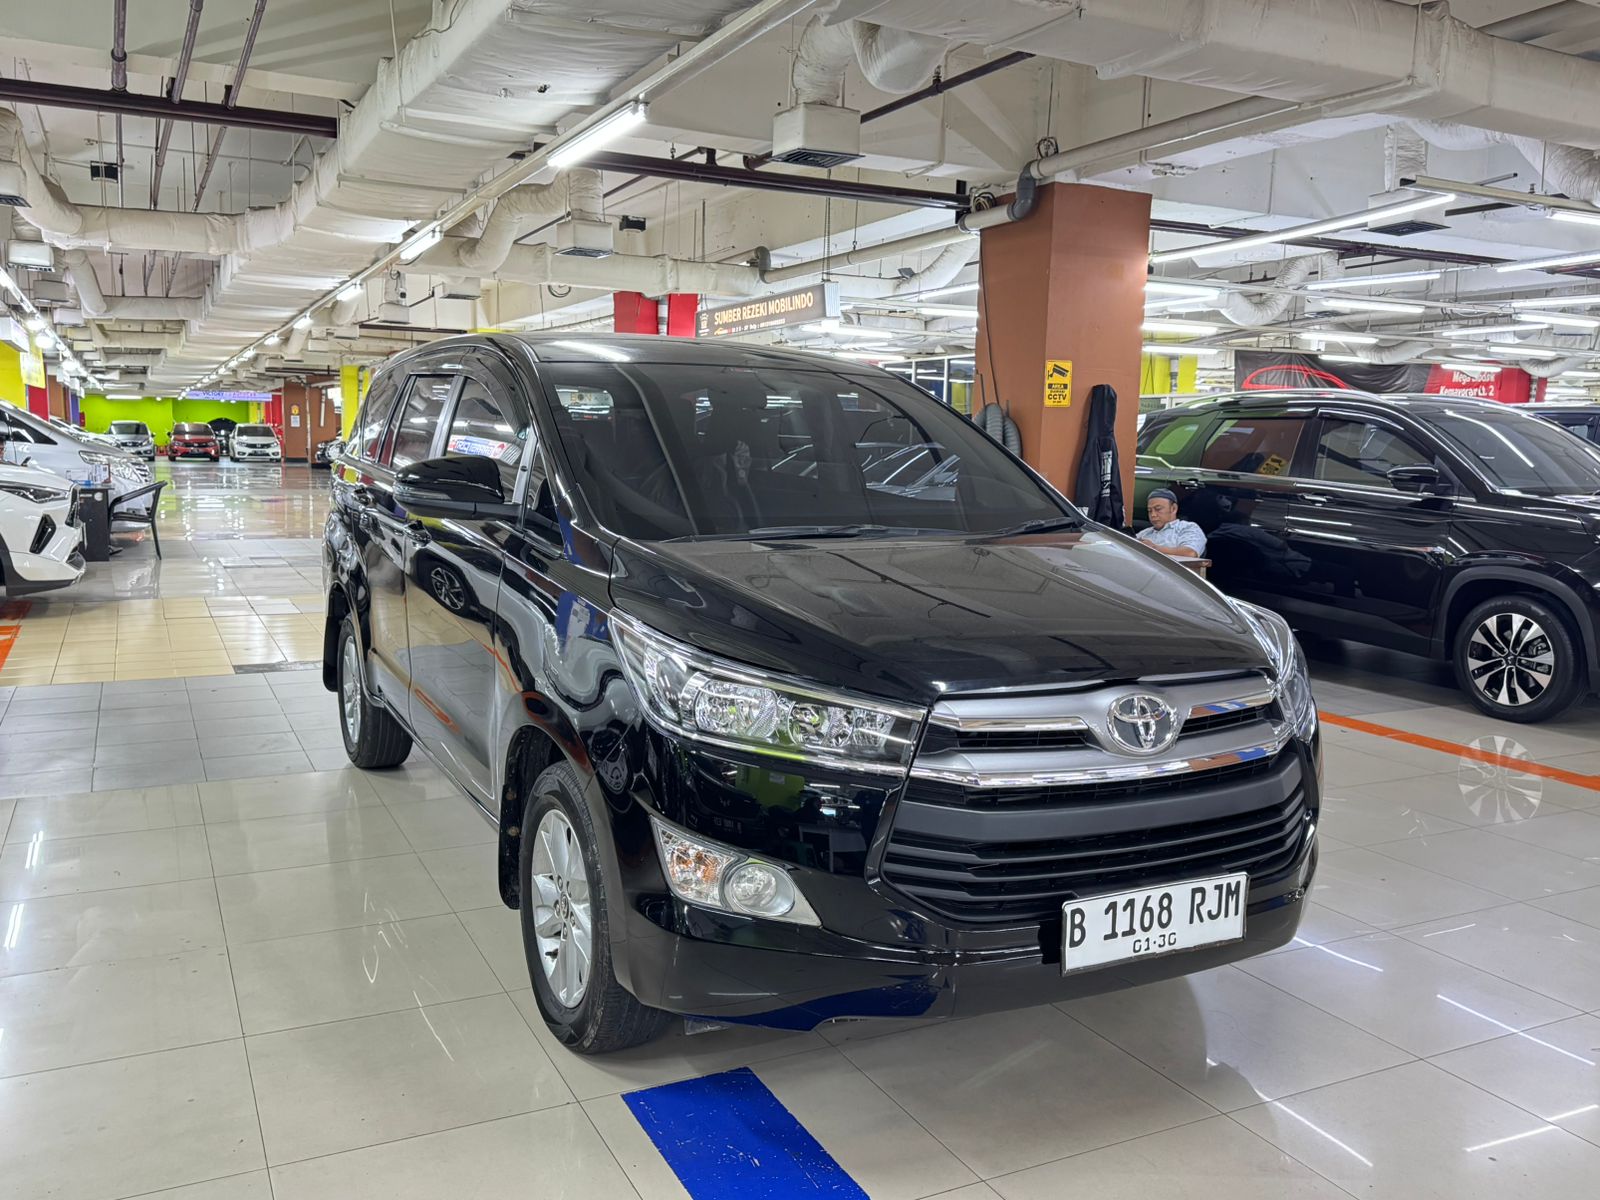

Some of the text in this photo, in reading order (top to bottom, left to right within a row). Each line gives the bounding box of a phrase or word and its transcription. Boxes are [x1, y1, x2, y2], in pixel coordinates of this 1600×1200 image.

[714, 307, 742, 325] SUMBER
[742, 301, 768, 320] REZEKI
[768, 291, 814, 315] MOBILINDO
[1488, 385, 1495, 397] 2
[1069, 880, 1241, 948] B 1168 RJM
